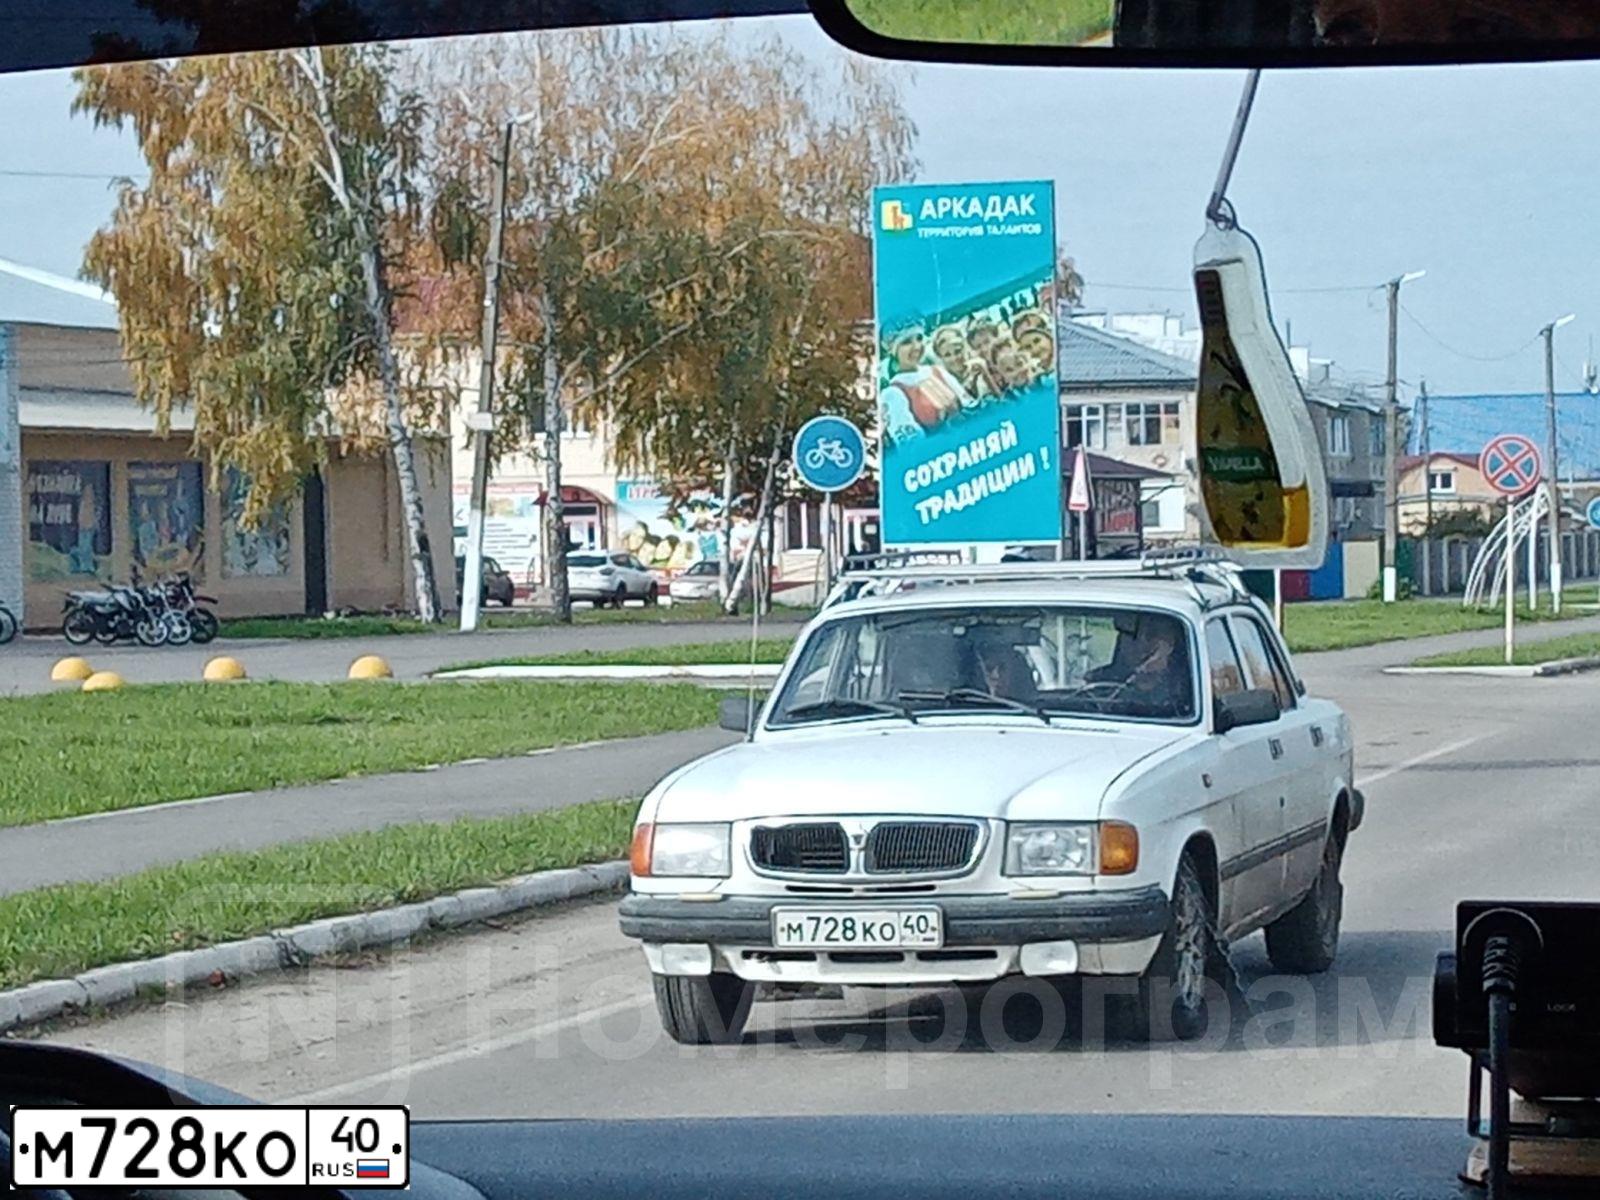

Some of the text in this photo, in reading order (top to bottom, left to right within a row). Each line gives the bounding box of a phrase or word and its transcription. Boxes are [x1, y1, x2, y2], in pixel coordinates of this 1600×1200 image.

[919, 193, 1036, 222] АРКАДАК
[903, 419, 1018, 492] СОХРАНЯЙ
[914, 452, 1036, 525] ТРАДИЦИИ
